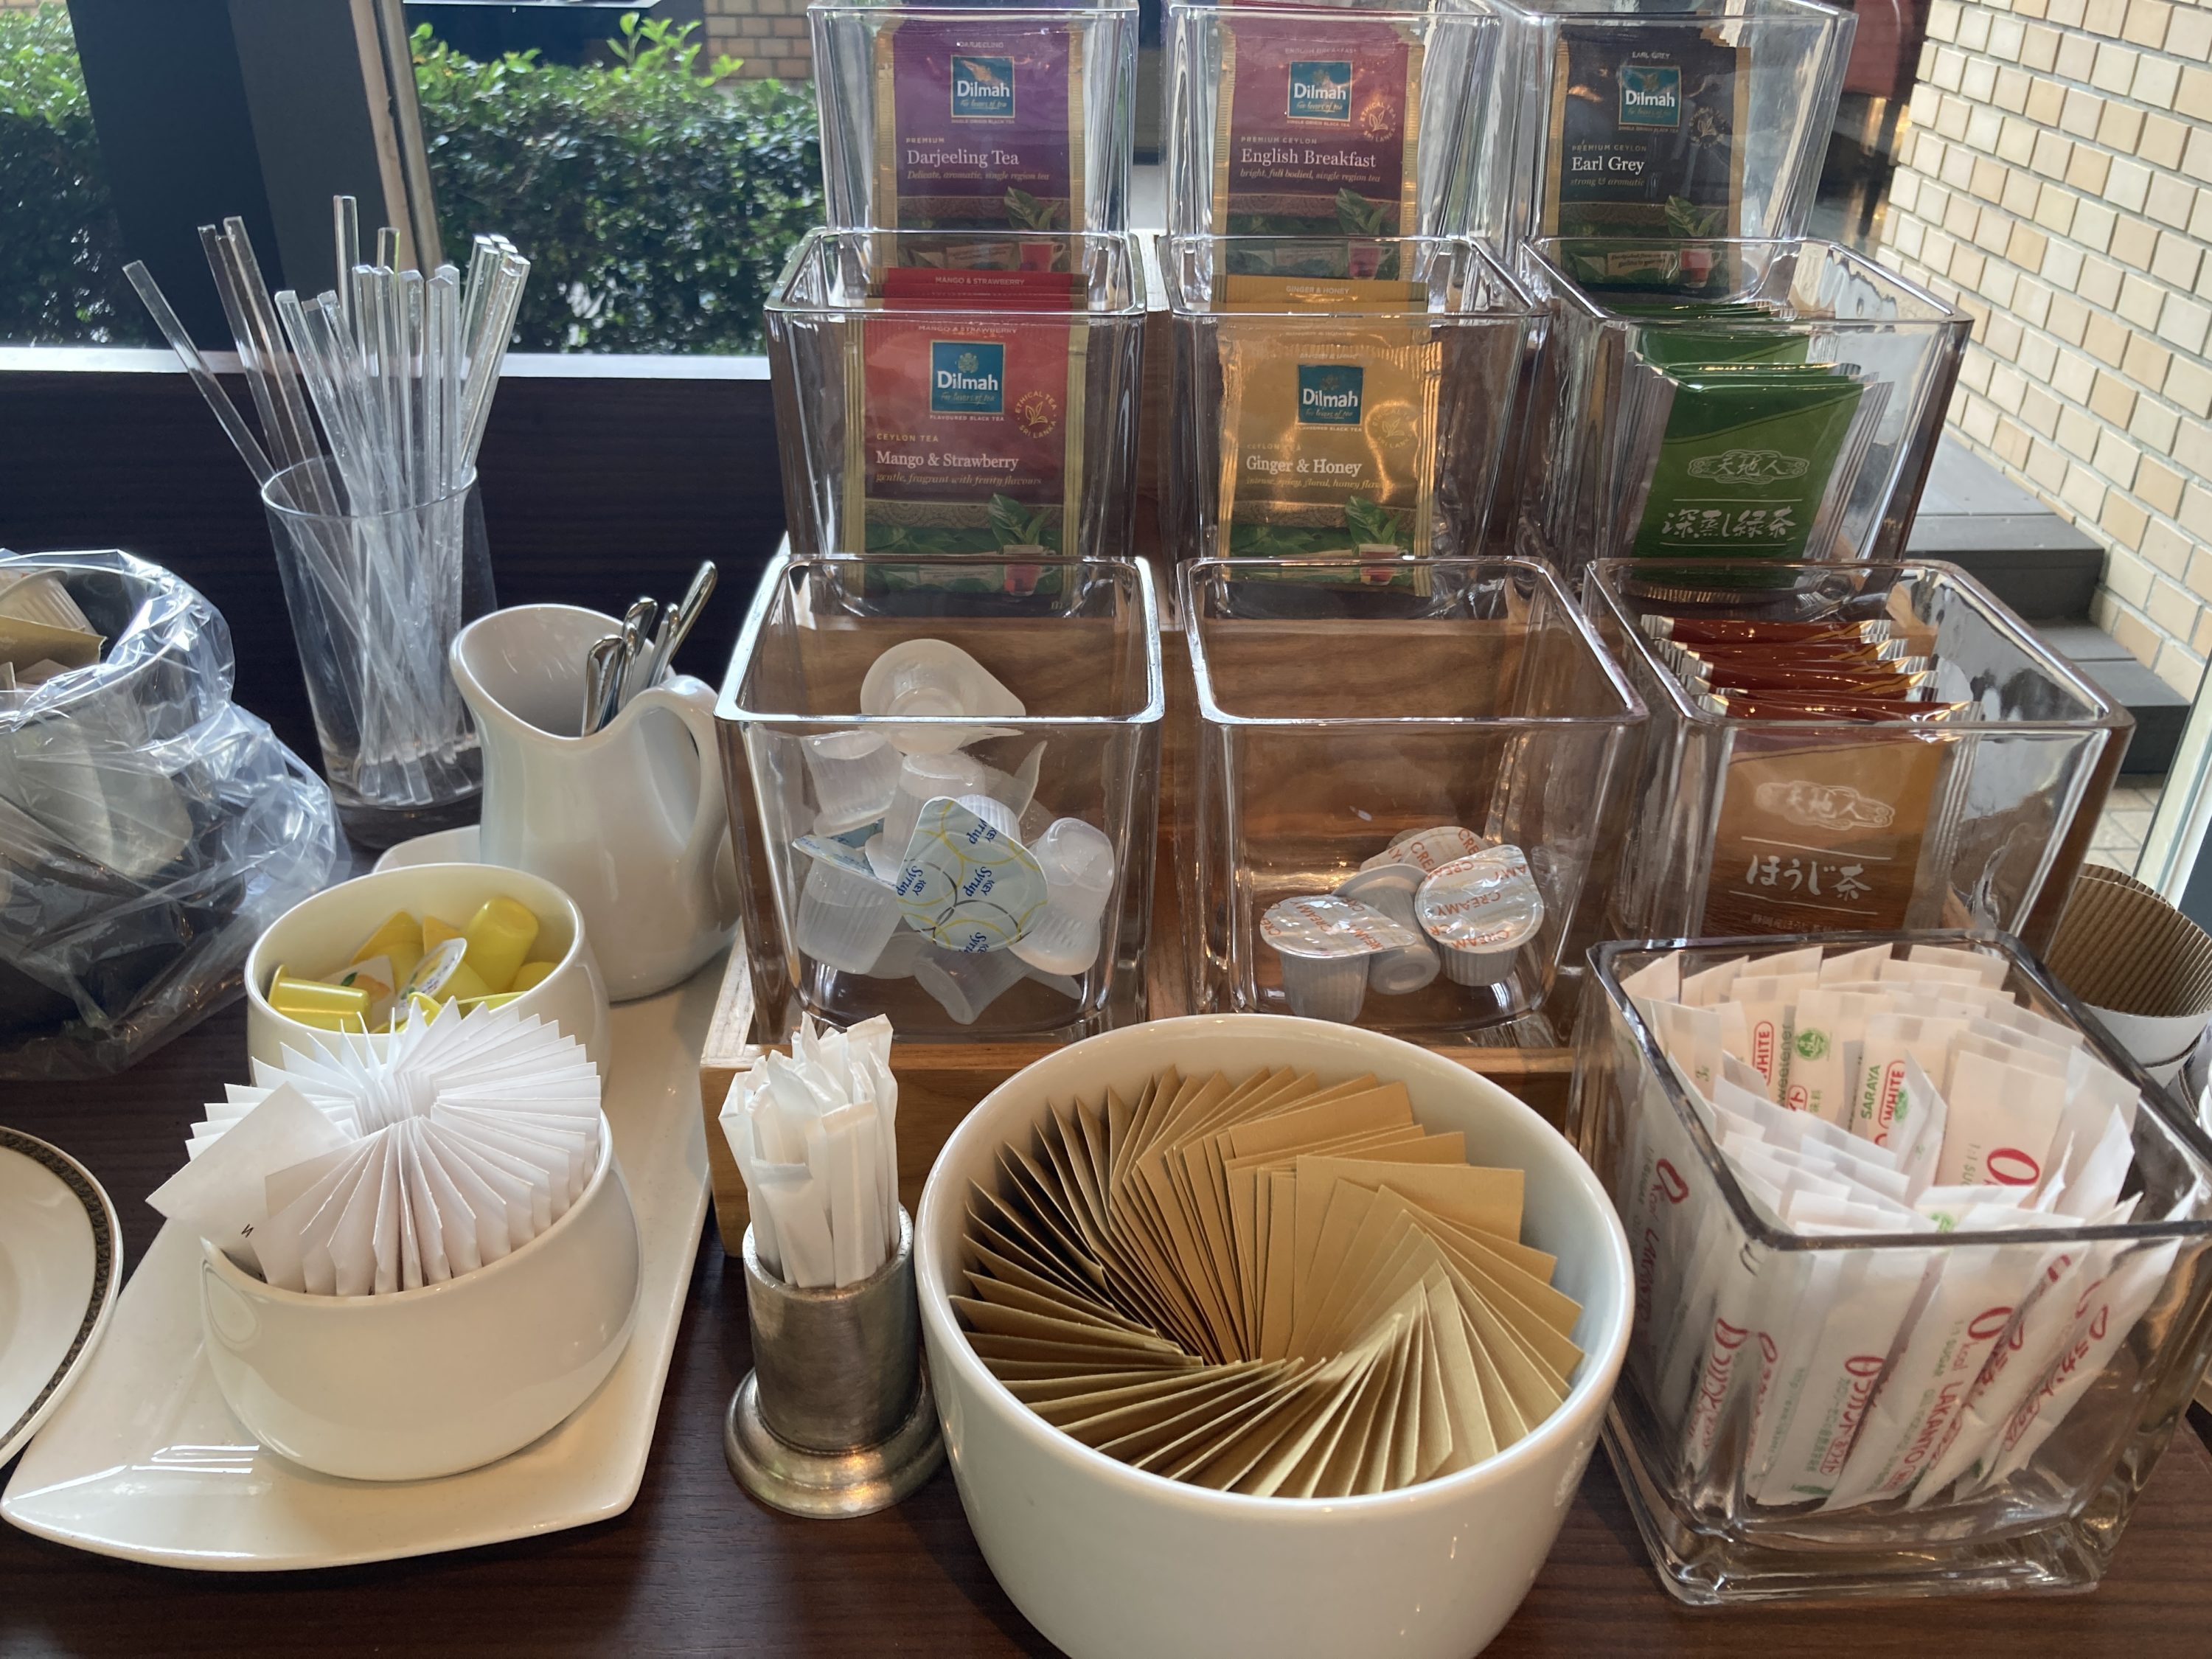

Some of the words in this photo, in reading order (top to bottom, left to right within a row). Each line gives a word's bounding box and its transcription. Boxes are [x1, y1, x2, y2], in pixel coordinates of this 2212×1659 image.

[957, 80, 1009, 97] Dilmah
[1293, 83, 1346, 100] Dilmah
[1625, 90, 1674, 107] Dilmah
[907, 149, 988, 168] Darjeeling
[992, 150, 1020, 165] Tea
[1240, 147, 1298, 167] English
[1304, 150, 1377, 167] Breakfast
[1571, 156, 1604, 171] Earl
[1607, 156, 1645, 175] Grey
[1284, 170, 1314, 180] bodied,
[1341, 173, 1366, 183] region
[1608, 178, 1645, 186] aromatic
[937, 370, 998, 391] Dilmah
[1015, 390, 1043, 414] ETHICAL
[1044, 394, 1057, 411] TEA
[1303, 388, 1358, 407] Dilmah
[877, 433, 916, 442] CEYLON
[1019, 425, 1032, 437] SRI
[1033, 420, 1057, 439] LANKA
[876, 451, 924, 469] Mango
[927, 453, 940, 467] &
[943, 453, 1019, 471] Strawberry
[1246, 455, 1293, 475] Ginger
[1296, 458, 1310, 473] &
[1312, 459, 1363, 477] Honey
[1712, 459, 1789, 477] 天地人
[908, 473, 949, 485] fragrant
[951, 474, 973, 484] with
[973, 475, 1004, 487] fruity
[1304, 479, 1330, 488] floral,
[1332, 479, 1360, 490] honey
[1661, 506, 1798, 539] 深蒸し緑茶
[966, 818, 988, 844] yrup
[984, 827, 998, 842] KEY
[896, 866, 923, 896] Syrup
[962, 866, 992, 897] Syrup
[1746, 854, 1873, 900] ほうじ茶
[912, 880, 927, 896] KEY
[981, 880, 995, 896] KEY
[1438, 891, 1500, 916] CREAMY
[1290, 900, 1333, 933] CREAMY
[964, 932, 987, 953] Syru
[1860, 1065, 1881, 1120] SARAYA
[1883, 1071, 1905, 1121] WHITE
[1905, 1381, 1964, 1464] LAKANTO
